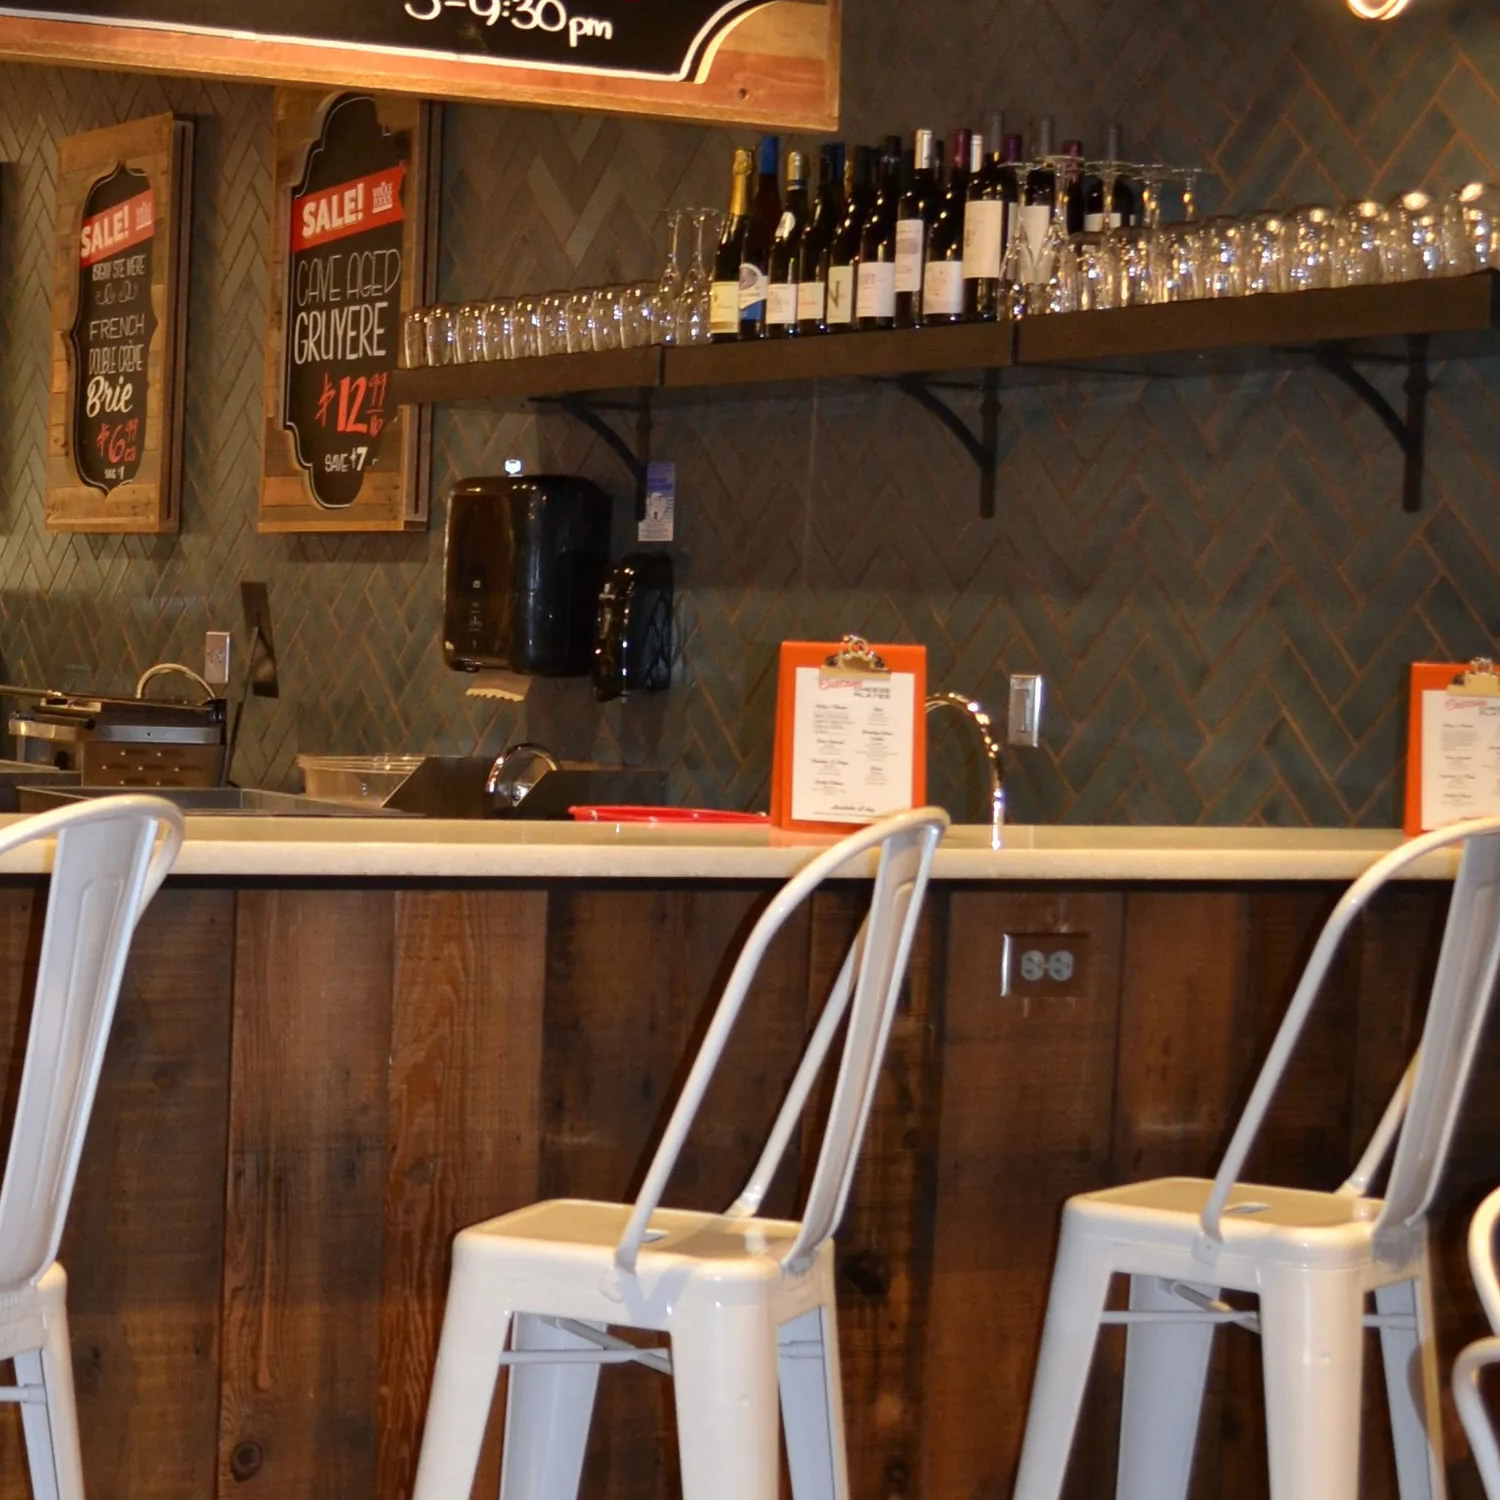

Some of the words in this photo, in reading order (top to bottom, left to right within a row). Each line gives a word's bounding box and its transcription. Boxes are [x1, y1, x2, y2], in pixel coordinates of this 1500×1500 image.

[81, 205, 130, 258] SALE!
[302, 182, 364, 238] SALE!
[297, 254, 342, 307] CAVE
[347, 249, 401, 299] AGED
[89, 313, 145, 341] FRENCH
[294, 302, 388, 365] GRUYERE
[86, 375, 133, 418] Brie
[324, 452, 348, 473] SAVE
